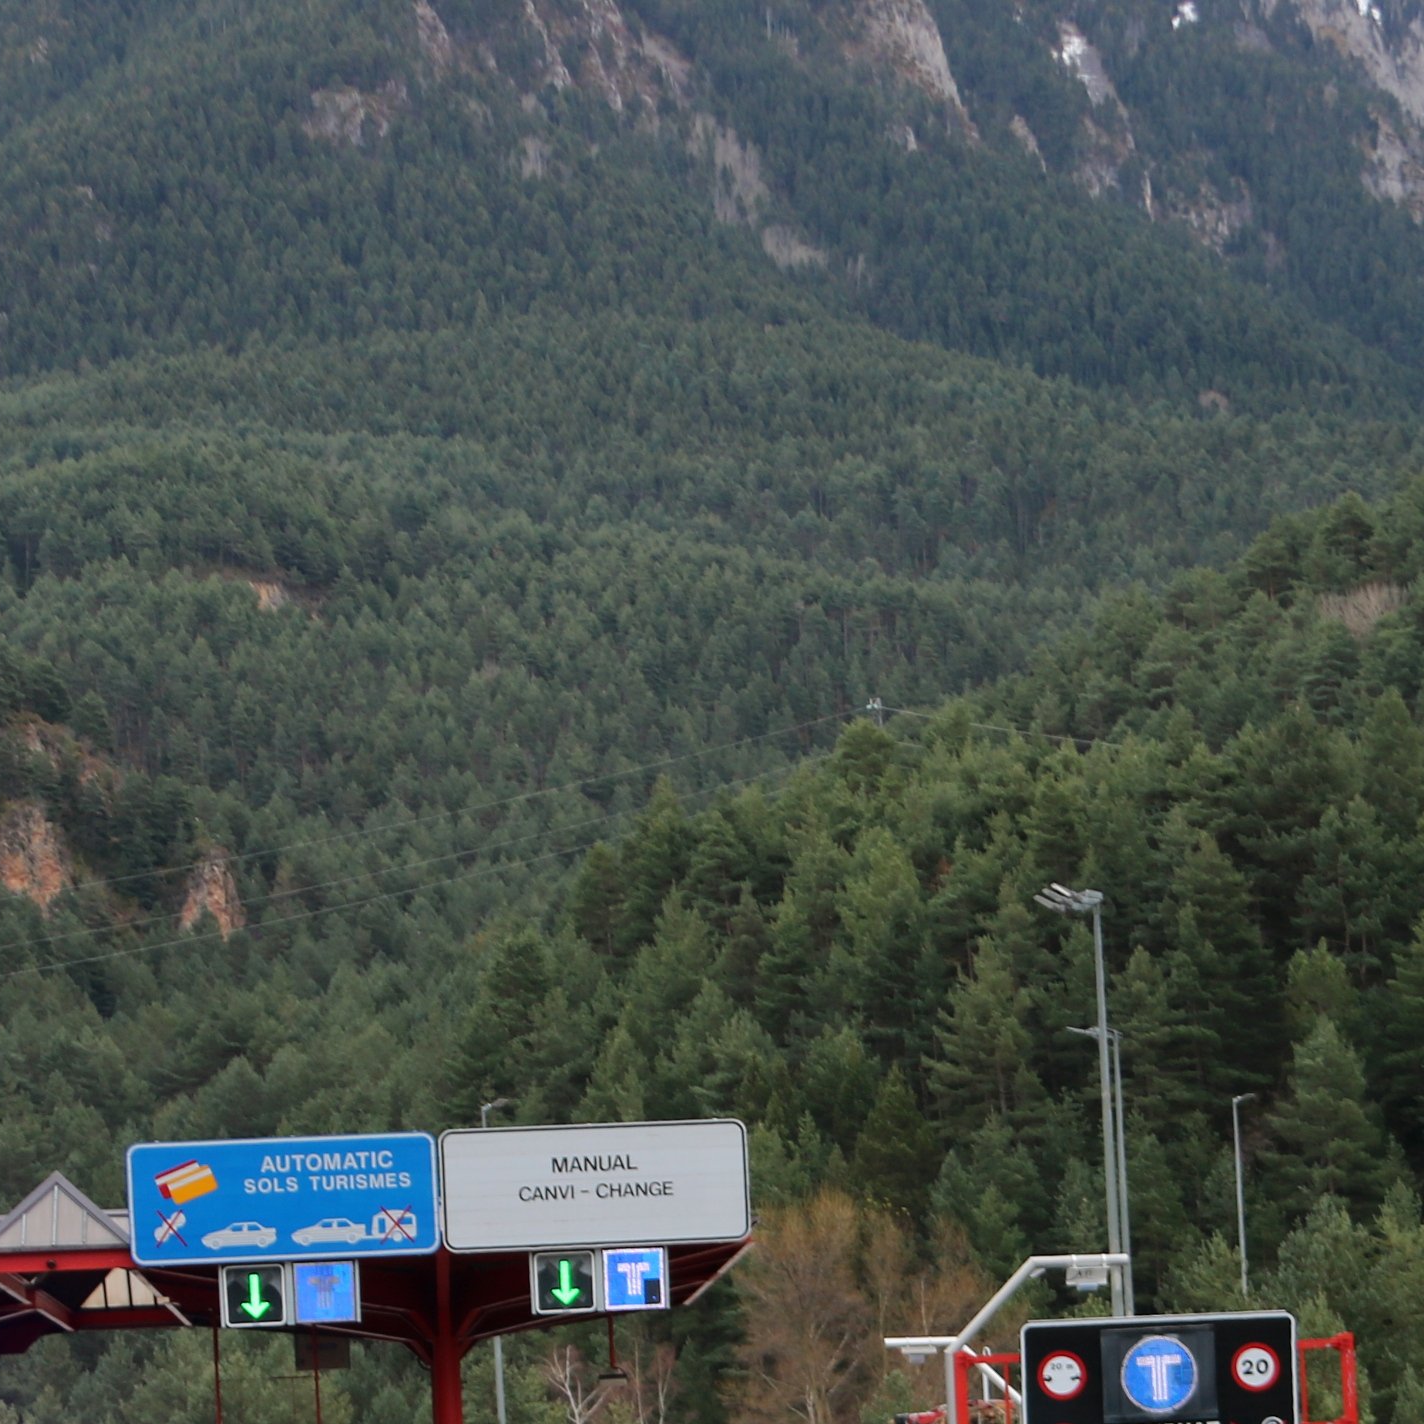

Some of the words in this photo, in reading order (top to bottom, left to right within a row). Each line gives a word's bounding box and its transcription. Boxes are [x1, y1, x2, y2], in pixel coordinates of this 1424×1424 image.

[260, 1150, 394, 1173] AUTOMATIC
[551, 1154, 638, 1174] MANUAL
[243, 1176, 299, 1194] SOLS
[309, 1172, 412, 1191] TURISMES
[518, 1185, 575, 1202] CANVI
[596, 1181, 674, 1199] CHANGE
[1241, 1358, 1269, 1376] 20
